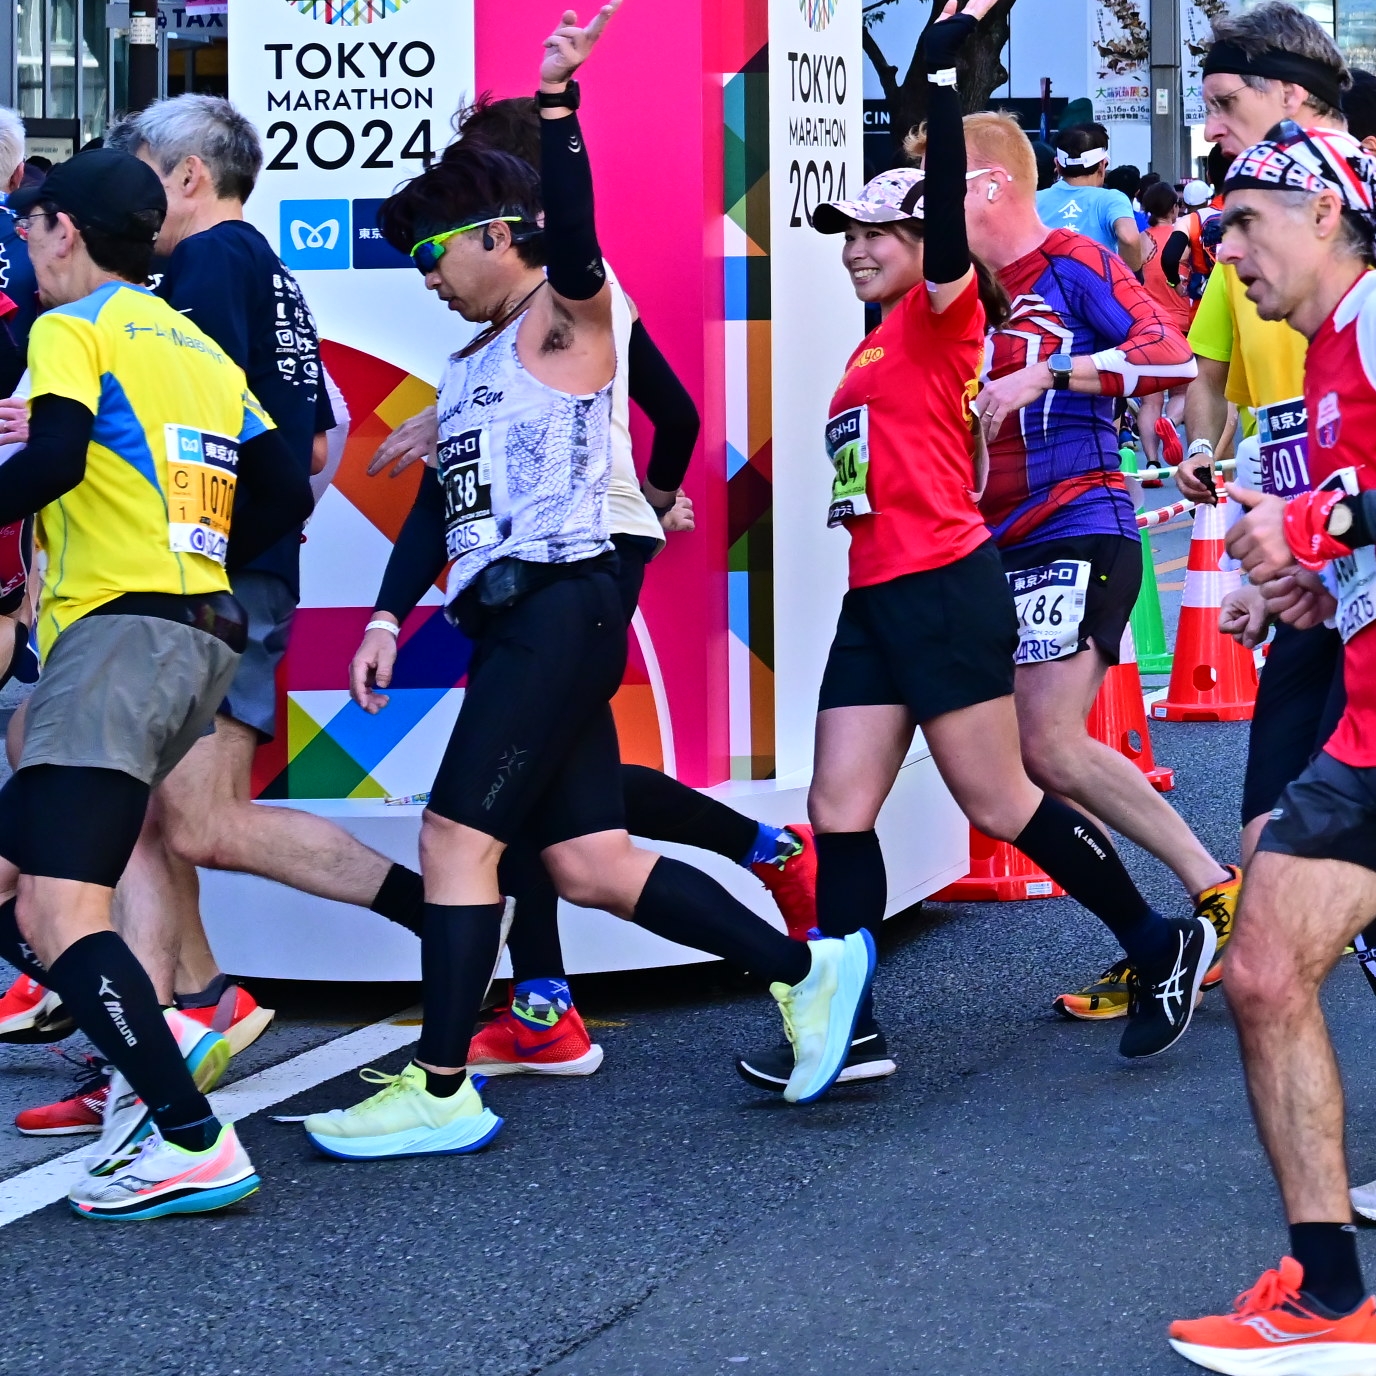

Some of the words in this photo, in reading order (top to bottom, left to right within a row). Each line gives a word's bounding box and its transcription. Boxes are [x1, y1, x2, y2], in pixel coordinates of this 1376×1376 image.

[264, 41, 435, 80] TOKYO
[787, 52, 847, 106] TOKYO
[266, 88, 434, 111] MARATHON
[264, 120, 437, 171] 2024
[788, 118, 847, 148] MARATHON
[174, 470, 189, 489] C
[179, 505, 186, 520] 1
[1014, 567, 1072, 591] 東京メトロ
